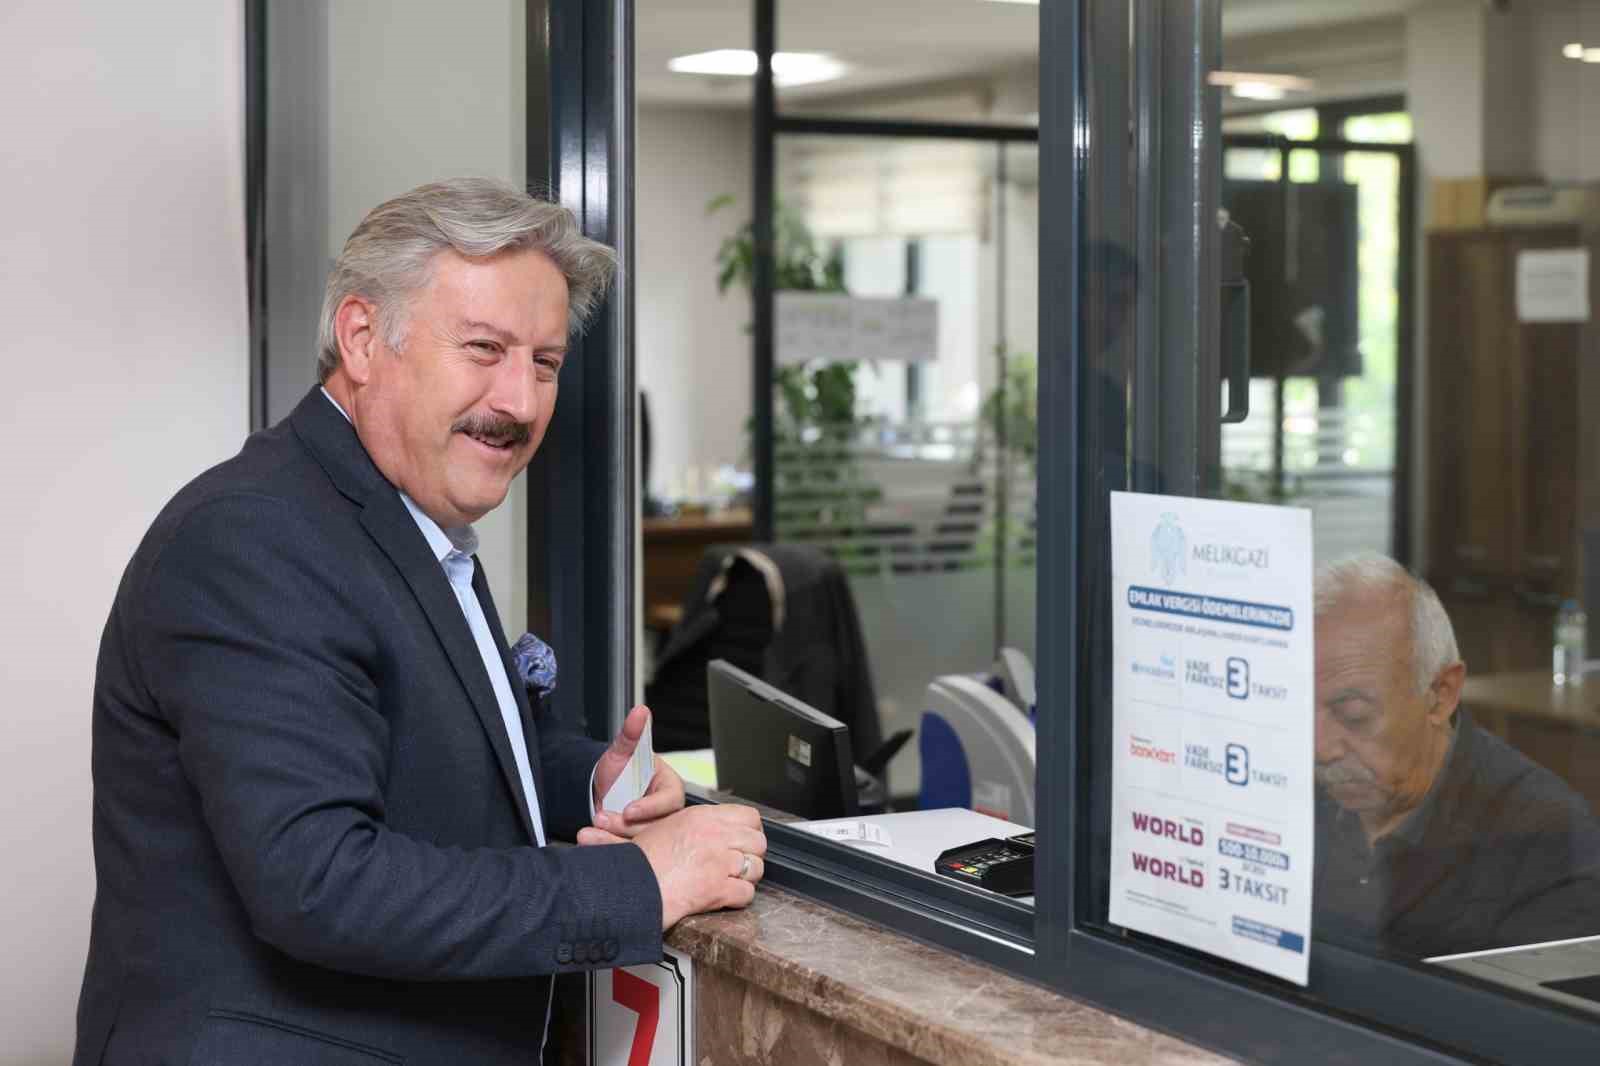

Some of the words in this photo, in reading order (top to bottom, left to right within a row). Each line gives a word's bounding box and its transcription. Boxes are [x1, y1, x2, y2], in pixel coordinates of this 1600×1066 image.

[1226, 656, 1249, 700] 3
[1225, 742, 1249, 786] 3
[1132, 811, 1204, 847] WORLD
[1132, 851, 1204, 888] WORLD
[1218, 867, 1230, 890] 3
[613, 966, 660, 1066] 7
